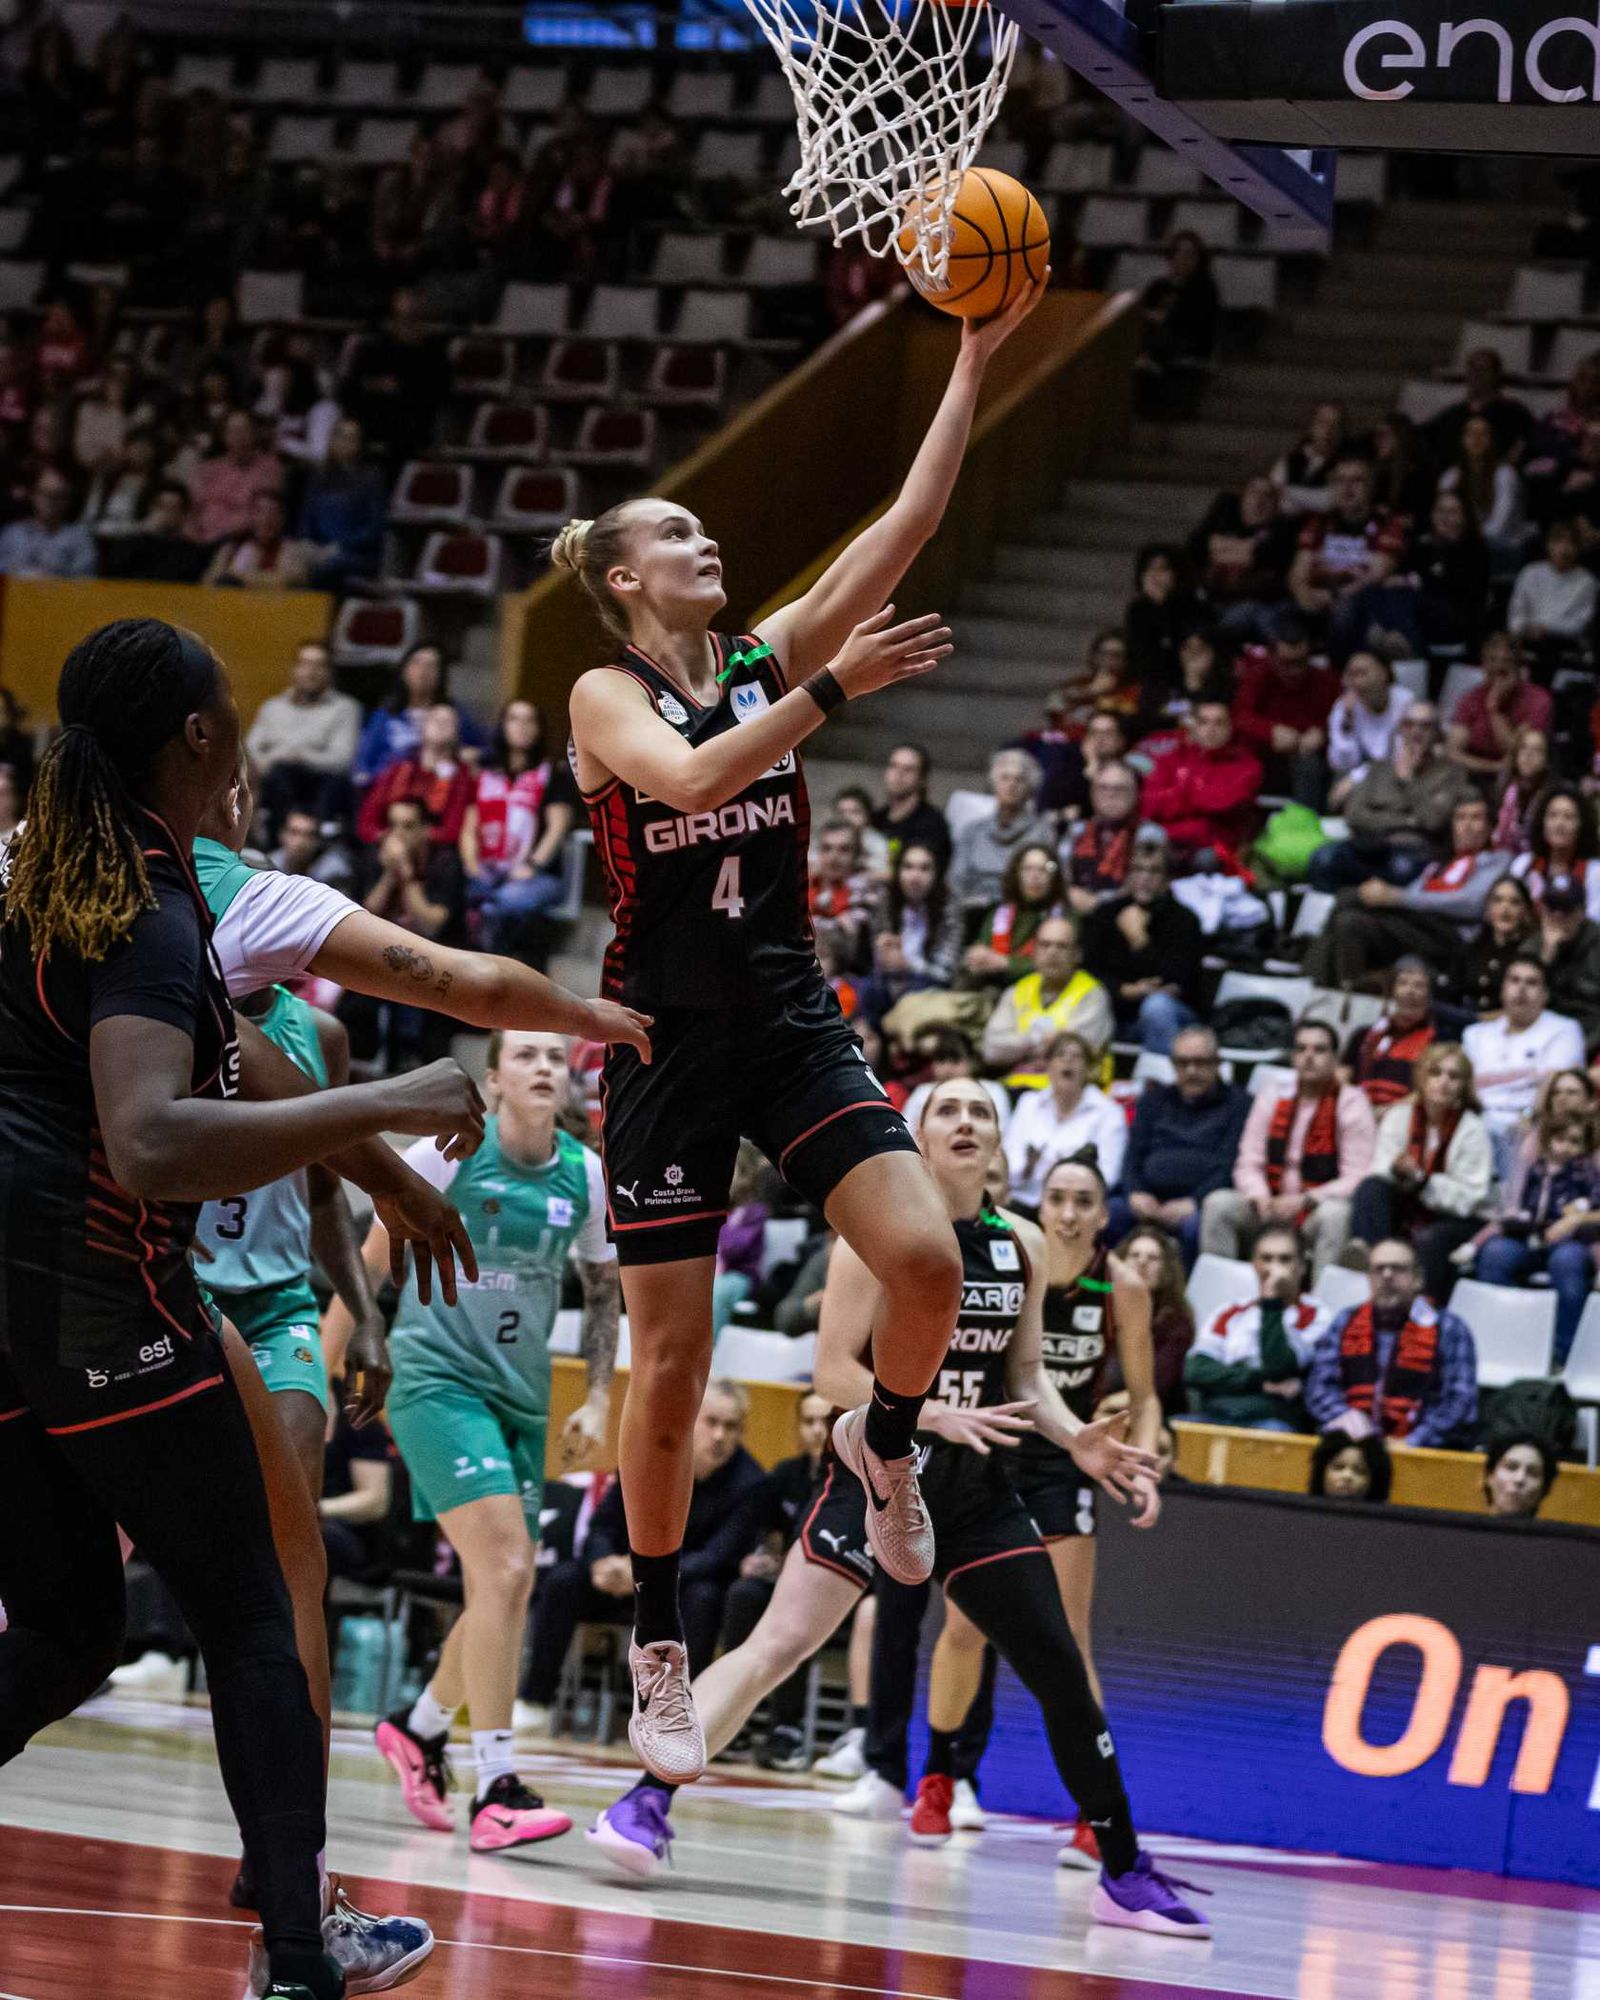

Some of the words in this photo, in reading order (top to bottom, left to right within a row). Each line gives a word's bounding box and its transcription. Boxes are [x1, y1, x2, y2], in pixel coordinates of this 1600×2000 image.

[643, 794, 795, 853] GIRONA
[712, 856, 745, 918] 4
[644, 1197, 672, 1205] Pirineu
[653, 1189, 675, 1197] Costa
[216, 1196, 248, 1240] 3
[496, 1311, 519, 1344] 2
[938, 1370, 985, 1408] 55
[1321, 1612, 1570, 1794] On
